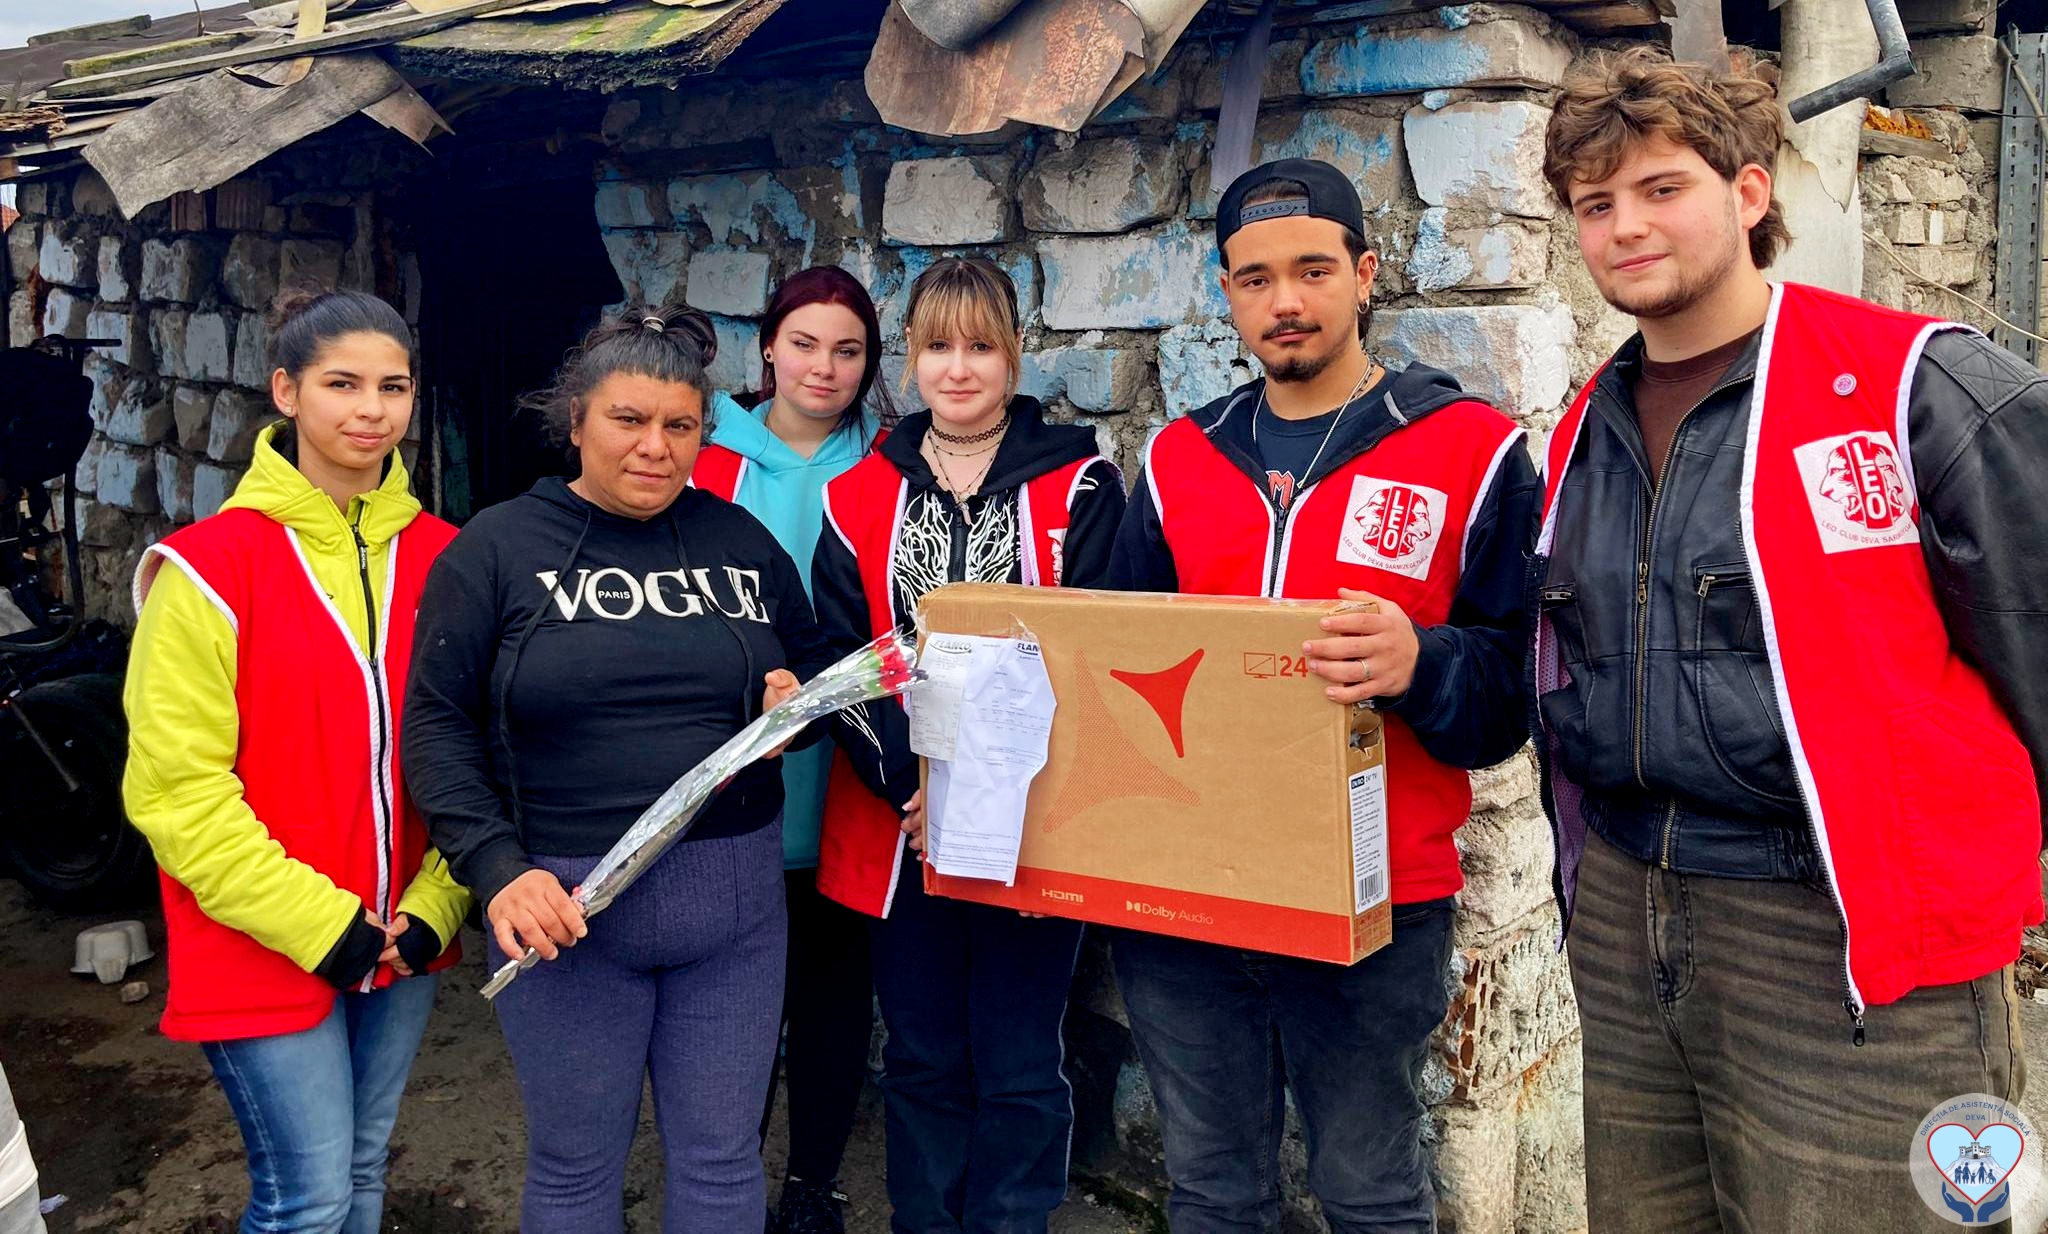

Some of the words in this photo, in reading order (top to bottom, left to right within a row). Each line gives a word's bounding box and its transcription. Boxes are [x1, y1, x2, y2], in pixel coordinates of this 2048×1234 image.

[1852, 441, 1886, 520] LEO
[1383, 490, 1405, 551] LEO
[1821, 520, 1837, 532] LEO
[1839, 529, 1858, 542] CLUB
[1343, 536, 1353, 548] LEO
[1352, 546, 1367, 559] CLUB
[1367, 556, 1383, 568] DEVA
[536, 565, 771, 624] VOGUE
[598, 590, 631, 600] PARIS
[1041, 888, 1084, 903] HDMI
[1142, 902, 1177, 921] Dolby
[1178, 909, 1214, 925] Audio
